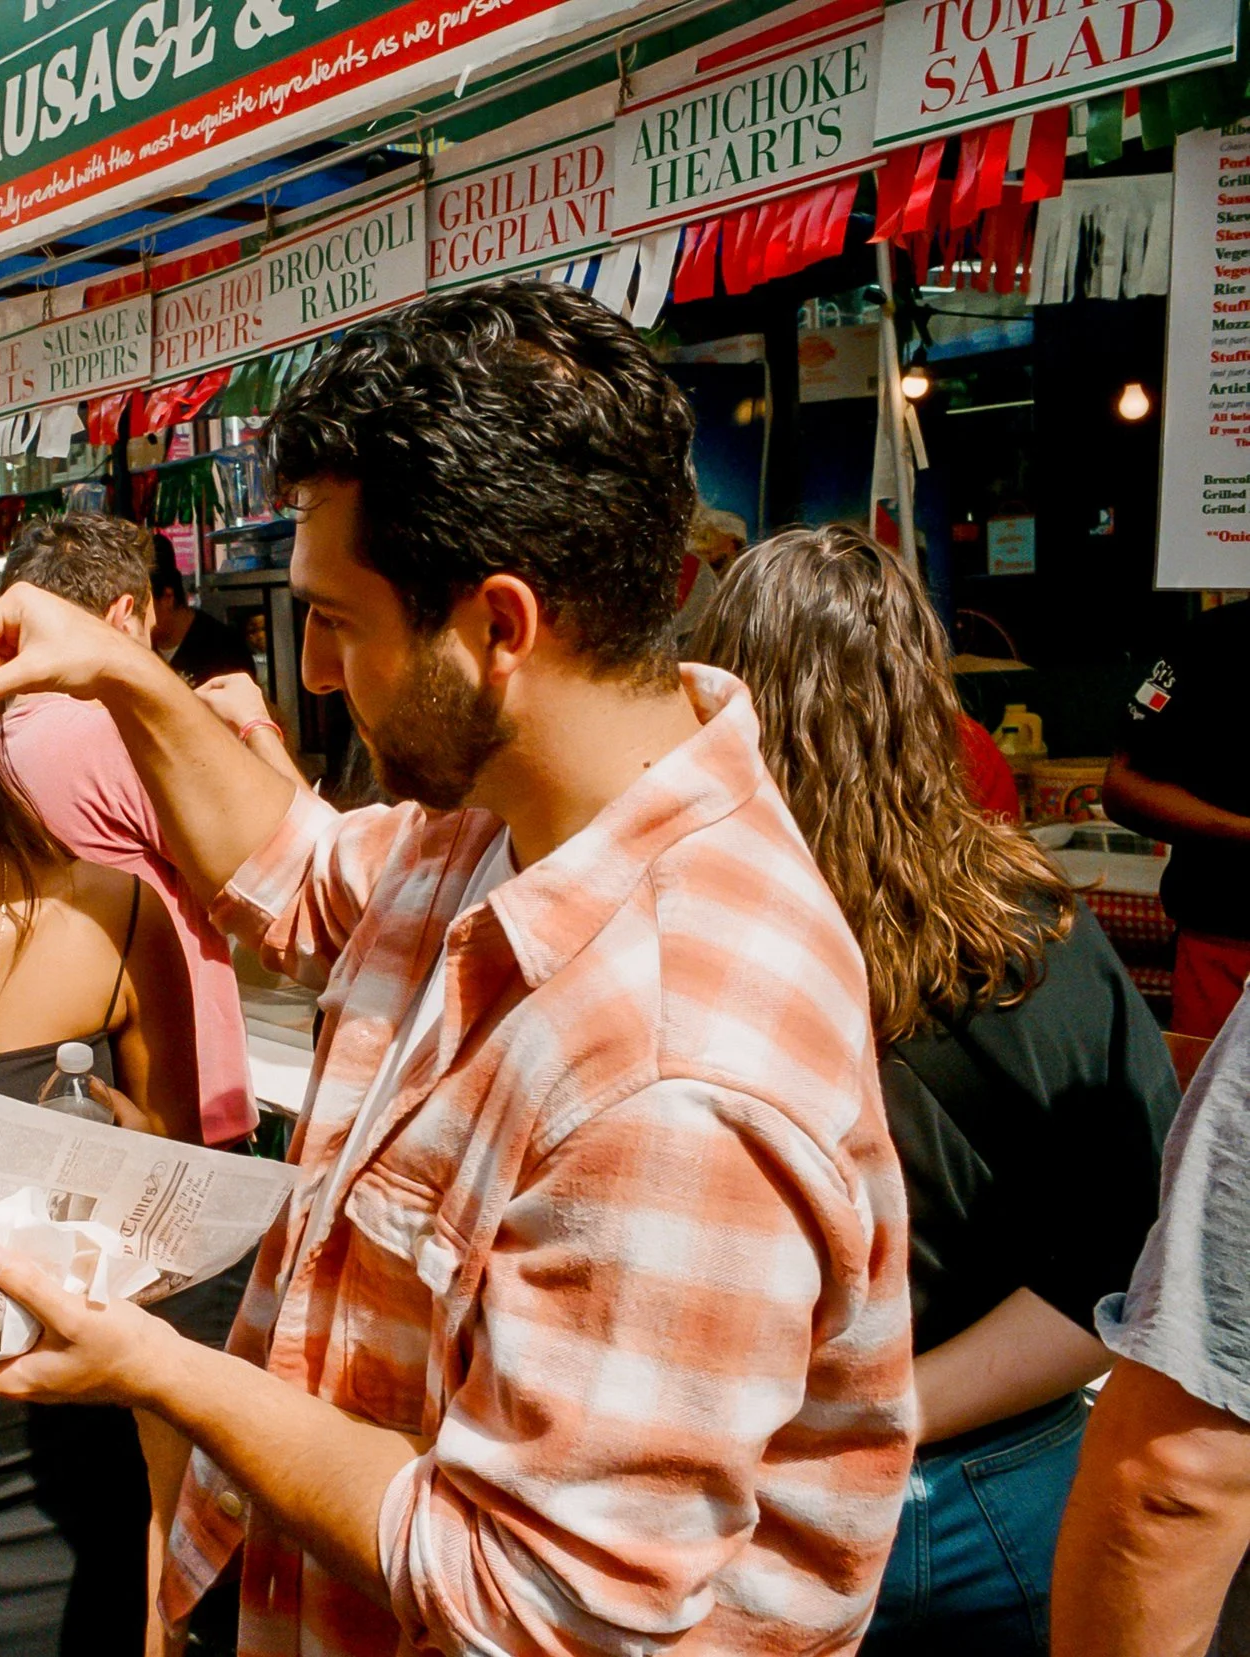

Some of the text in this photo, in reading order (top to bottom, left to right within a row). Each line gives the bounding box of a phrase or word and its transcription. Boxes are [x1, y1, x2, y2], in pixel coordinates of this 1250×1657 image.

[920, 0, 1174, 115] SALAD
[22, 167, 75, 207] created
[77, 154, 106, 187] with
[107, 145, 135, 174] the
[139, 119, 179, 160] most
[181, 87, 257, 144] exquisite
[258, 39, 368, 115] ingredients
[372, 34, 400, 61] as
[403, 20, 437, 49] we
[631, 41, 867, 165] ARTICHOKE
[438, 144, 605, 231] GRILLED
[646, 105, 842, 210] HEARTS
[267, 203, 416, 296] BROCCOLI
[428, 187, 615, 280] EGGPLANT
[152, 268, 262, 336] LONG HOT
[300, 262, 378, 324] RABE
[1213, 283, 1246, 295] Rice
[42, 306, 148, 361] SAUSAGE &
[49, 341, 139, 393] PEPPERS
[152, 304, 262, 372] PEPPERS
[1202, 504, 1246, 515] Grilled
[1203, 489, 1246, 500] Grilled
[119, 1188, 158, 1238] Times
